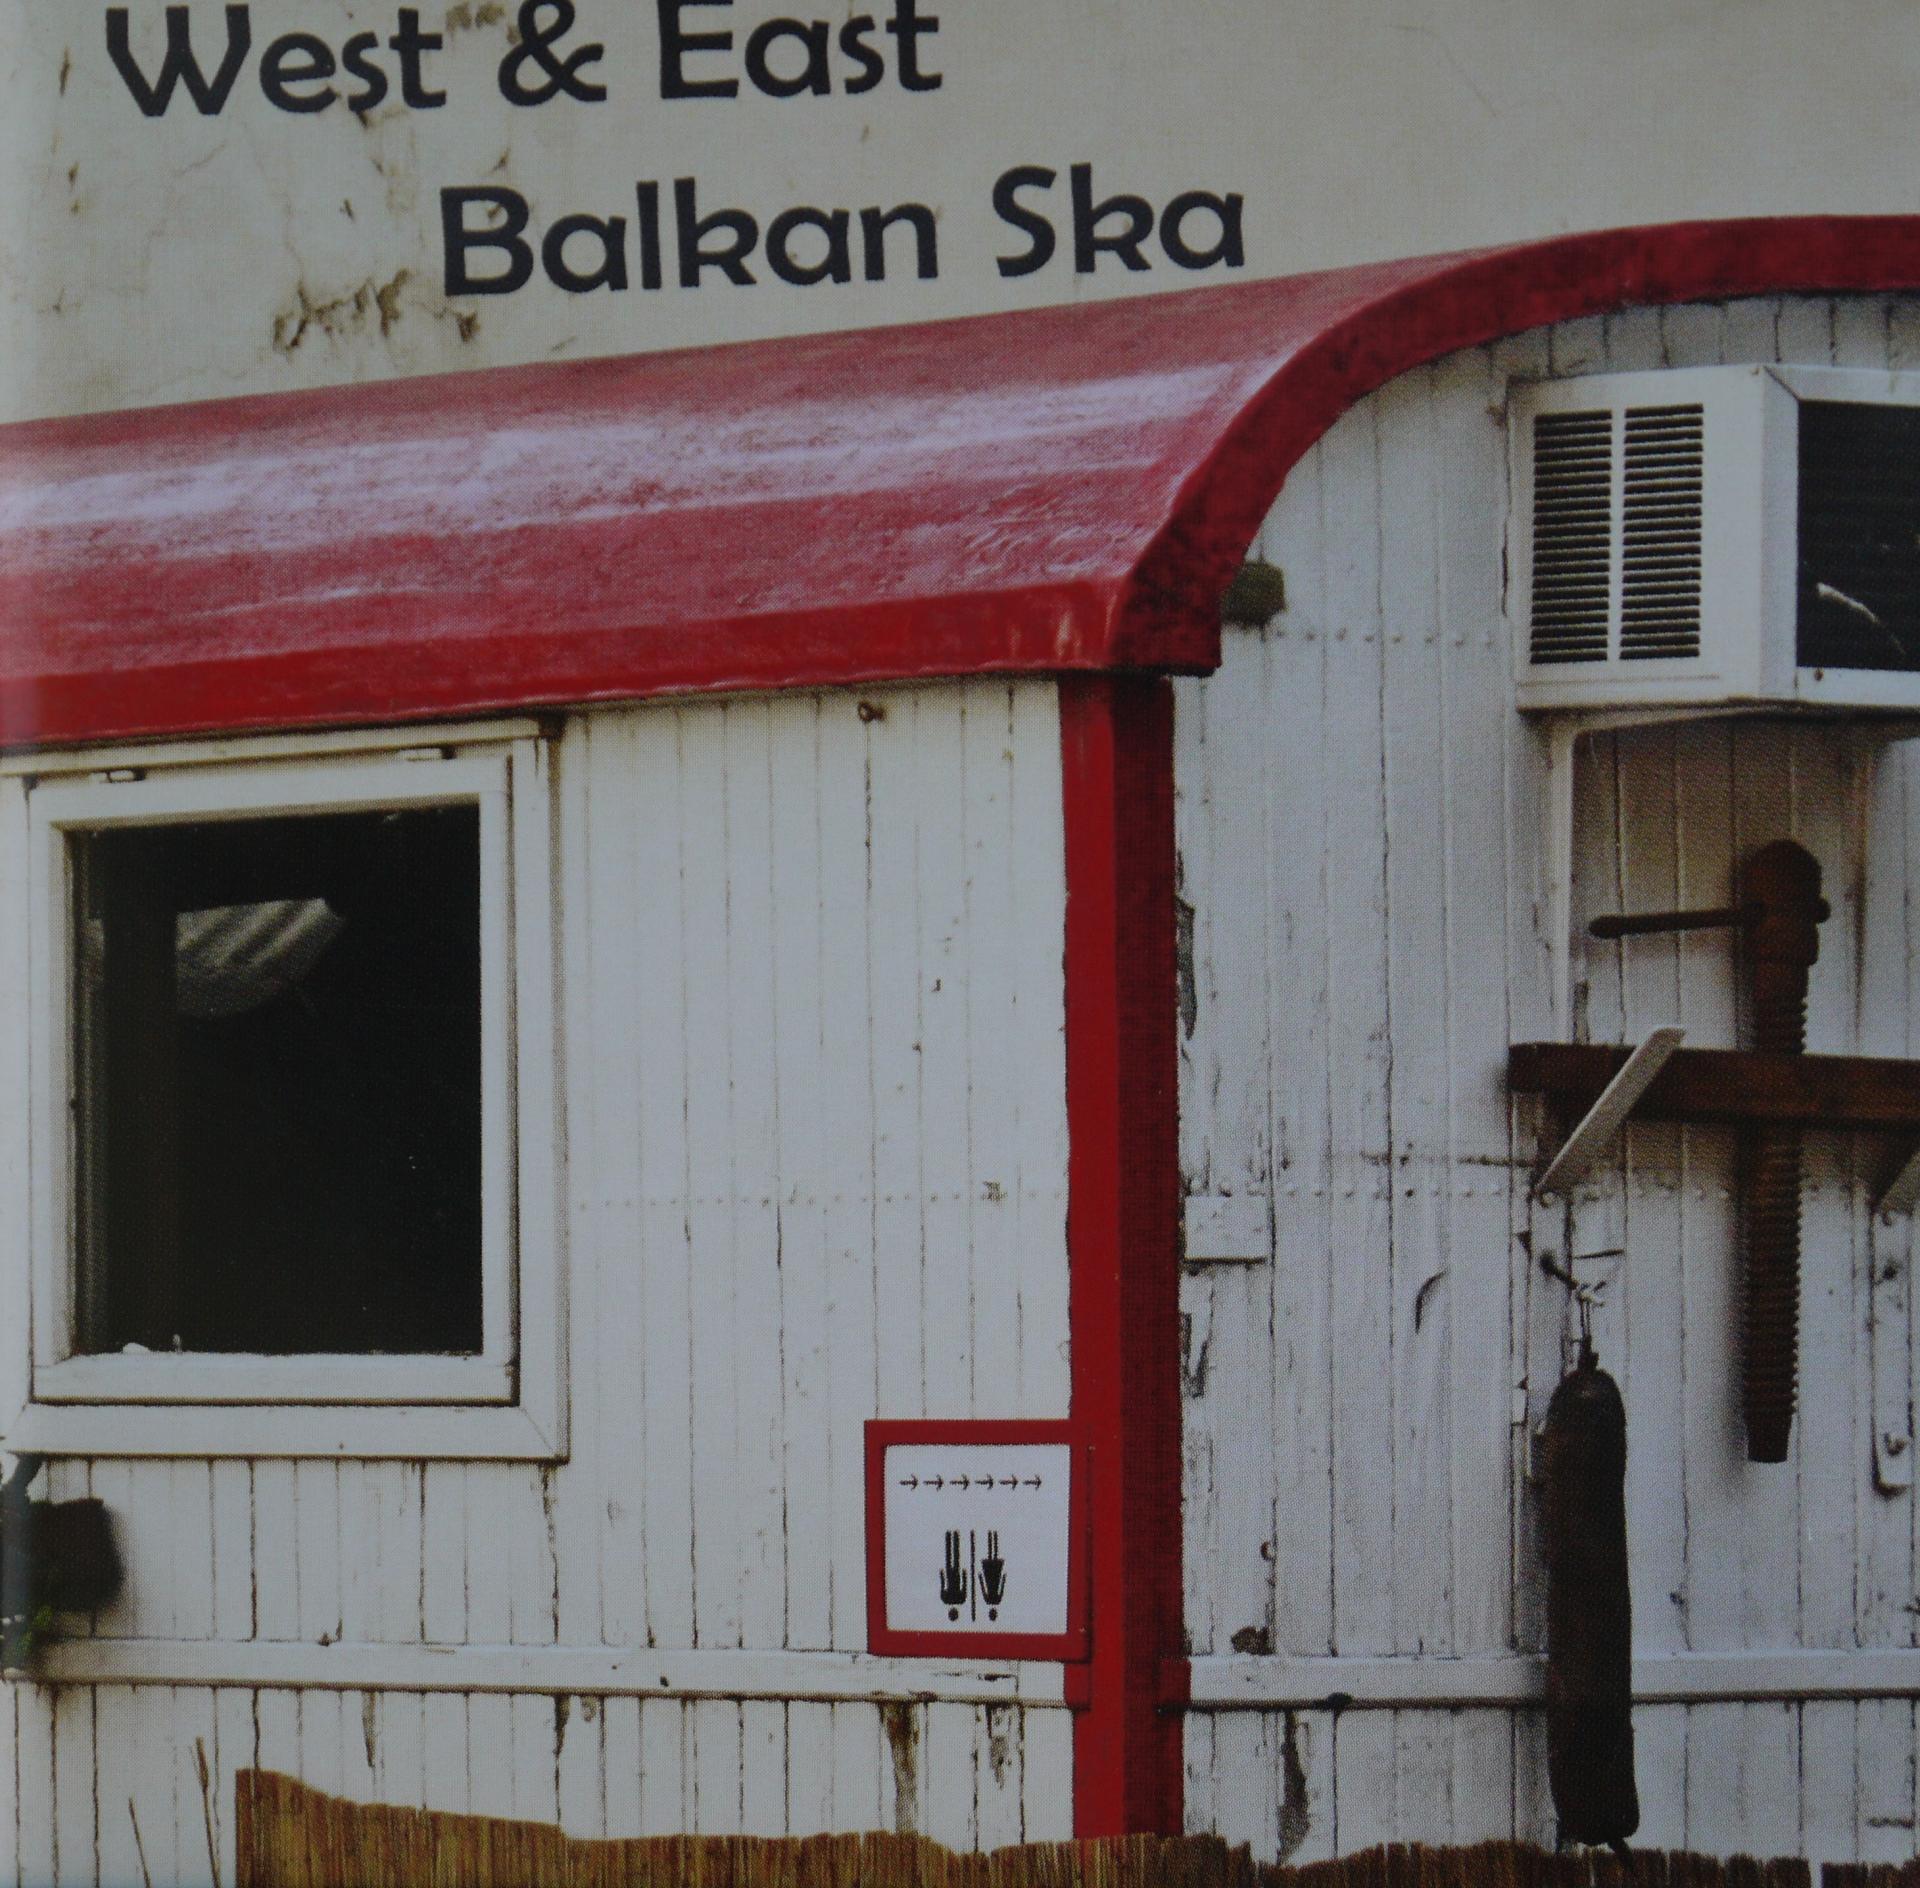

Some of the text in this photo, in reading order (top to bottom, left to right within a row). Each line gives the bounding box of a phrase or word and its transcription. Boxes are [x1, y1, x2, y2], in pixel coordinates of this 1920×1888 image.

[105, 0, 943, 117] West & East
[440, 163, 1245, 298] Balkan Ska
